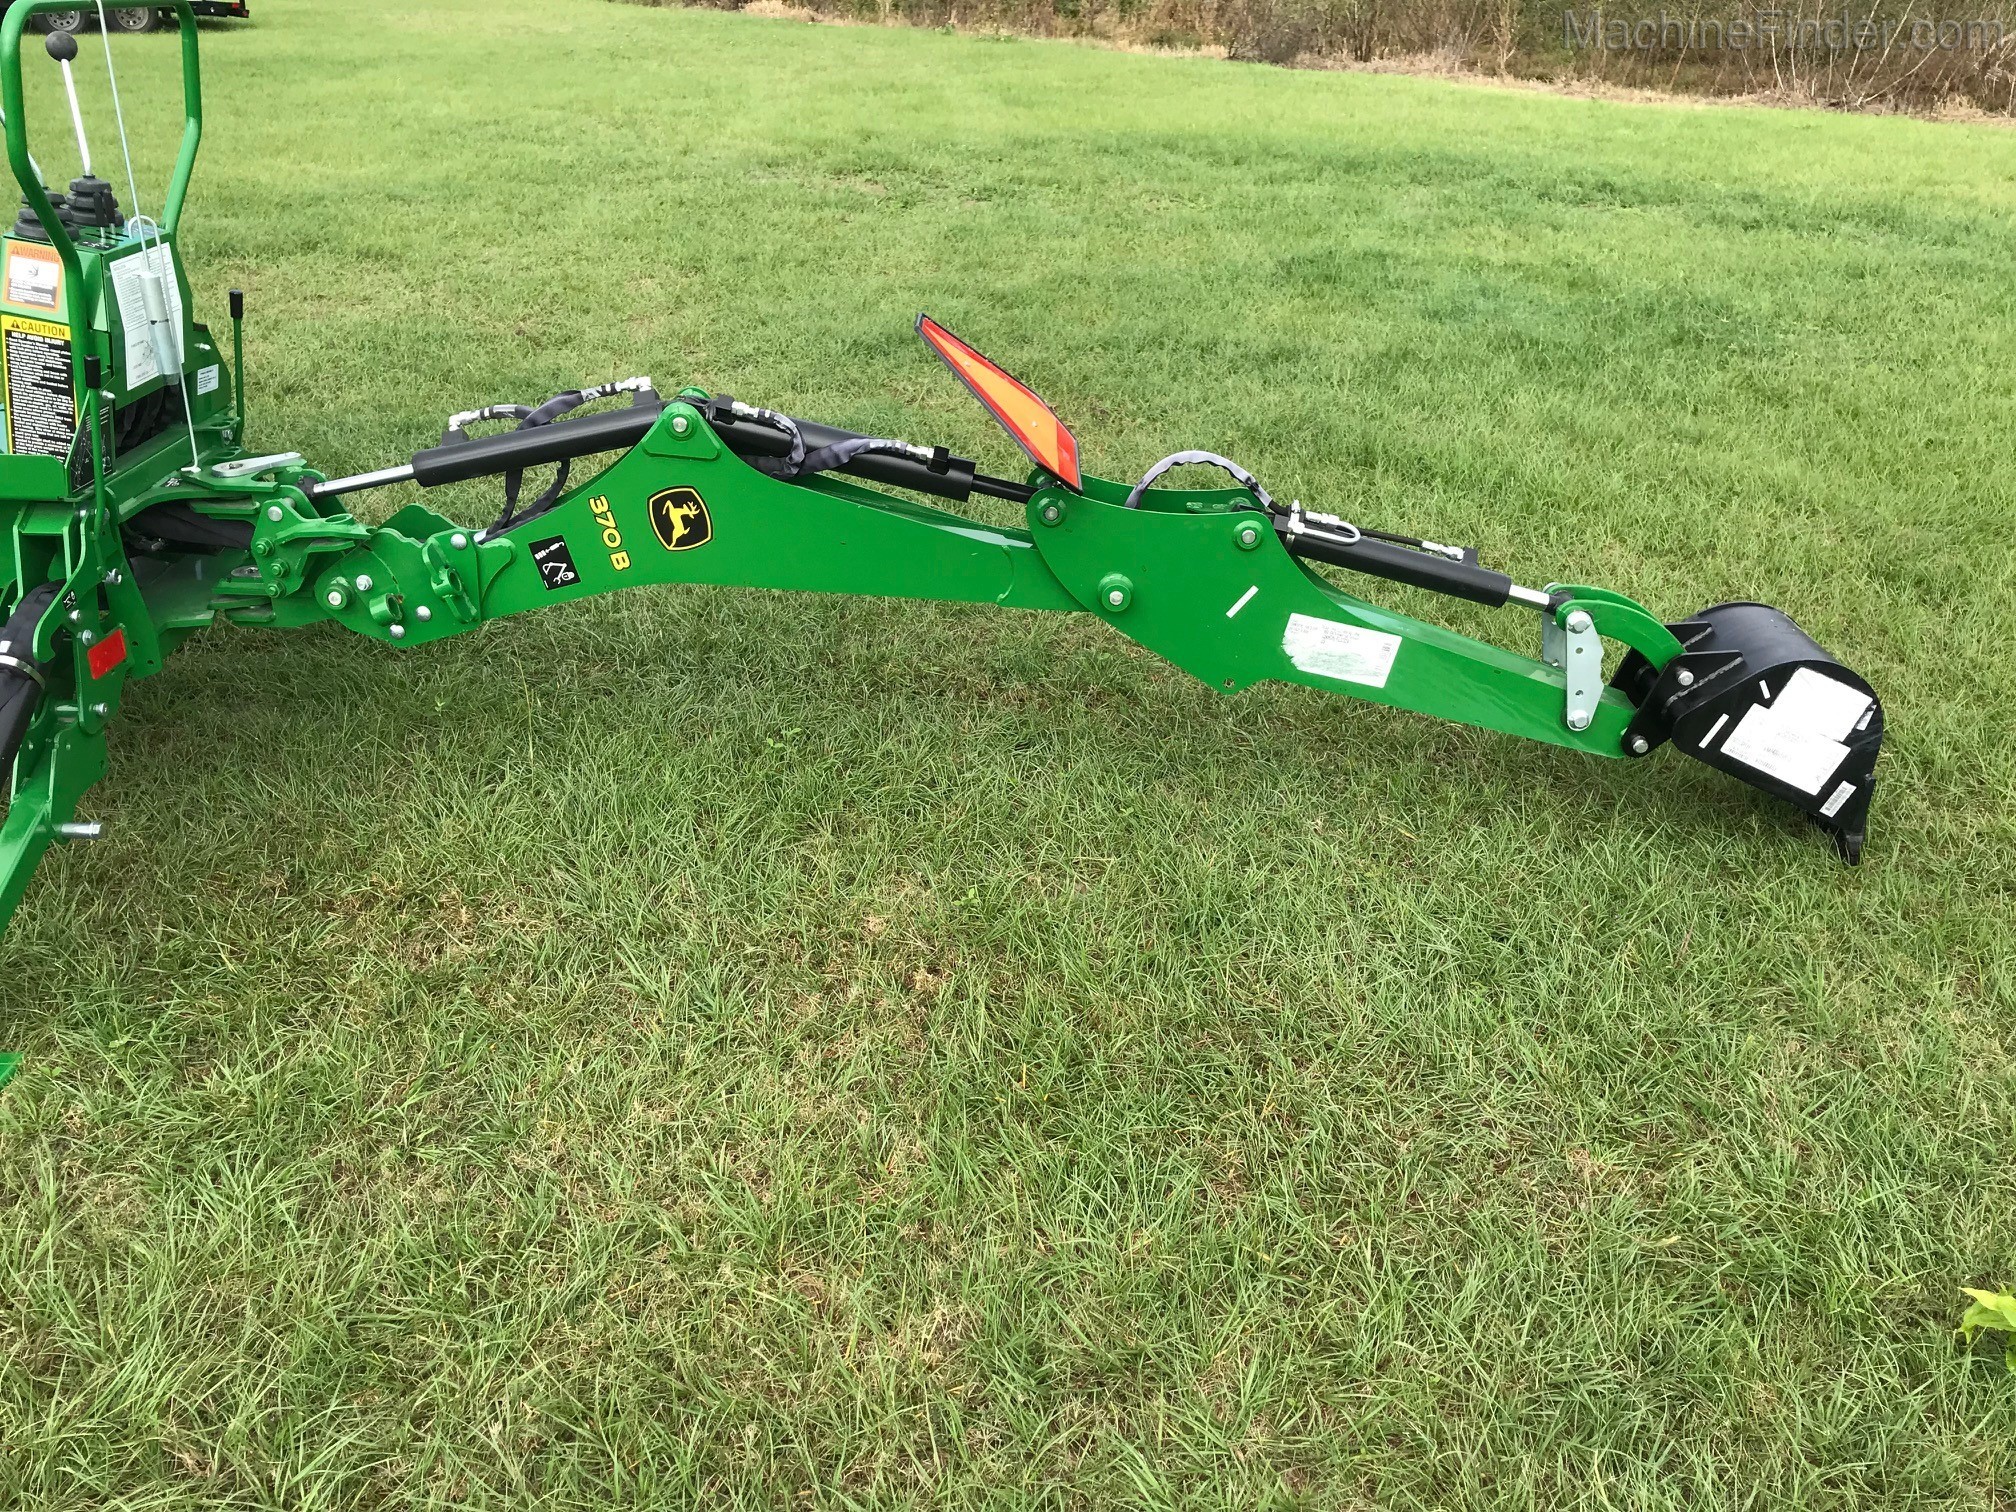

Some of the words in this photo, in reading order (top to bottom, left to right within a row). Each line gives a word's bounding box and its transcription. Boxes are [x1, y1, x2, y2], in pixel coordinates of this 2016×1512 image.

[20, 246, 60, 263] WARNING
[21, 320, 65, 336] CAUTION
[588, 495, 622, 547] 370
[609, 551, 631, 571] B
